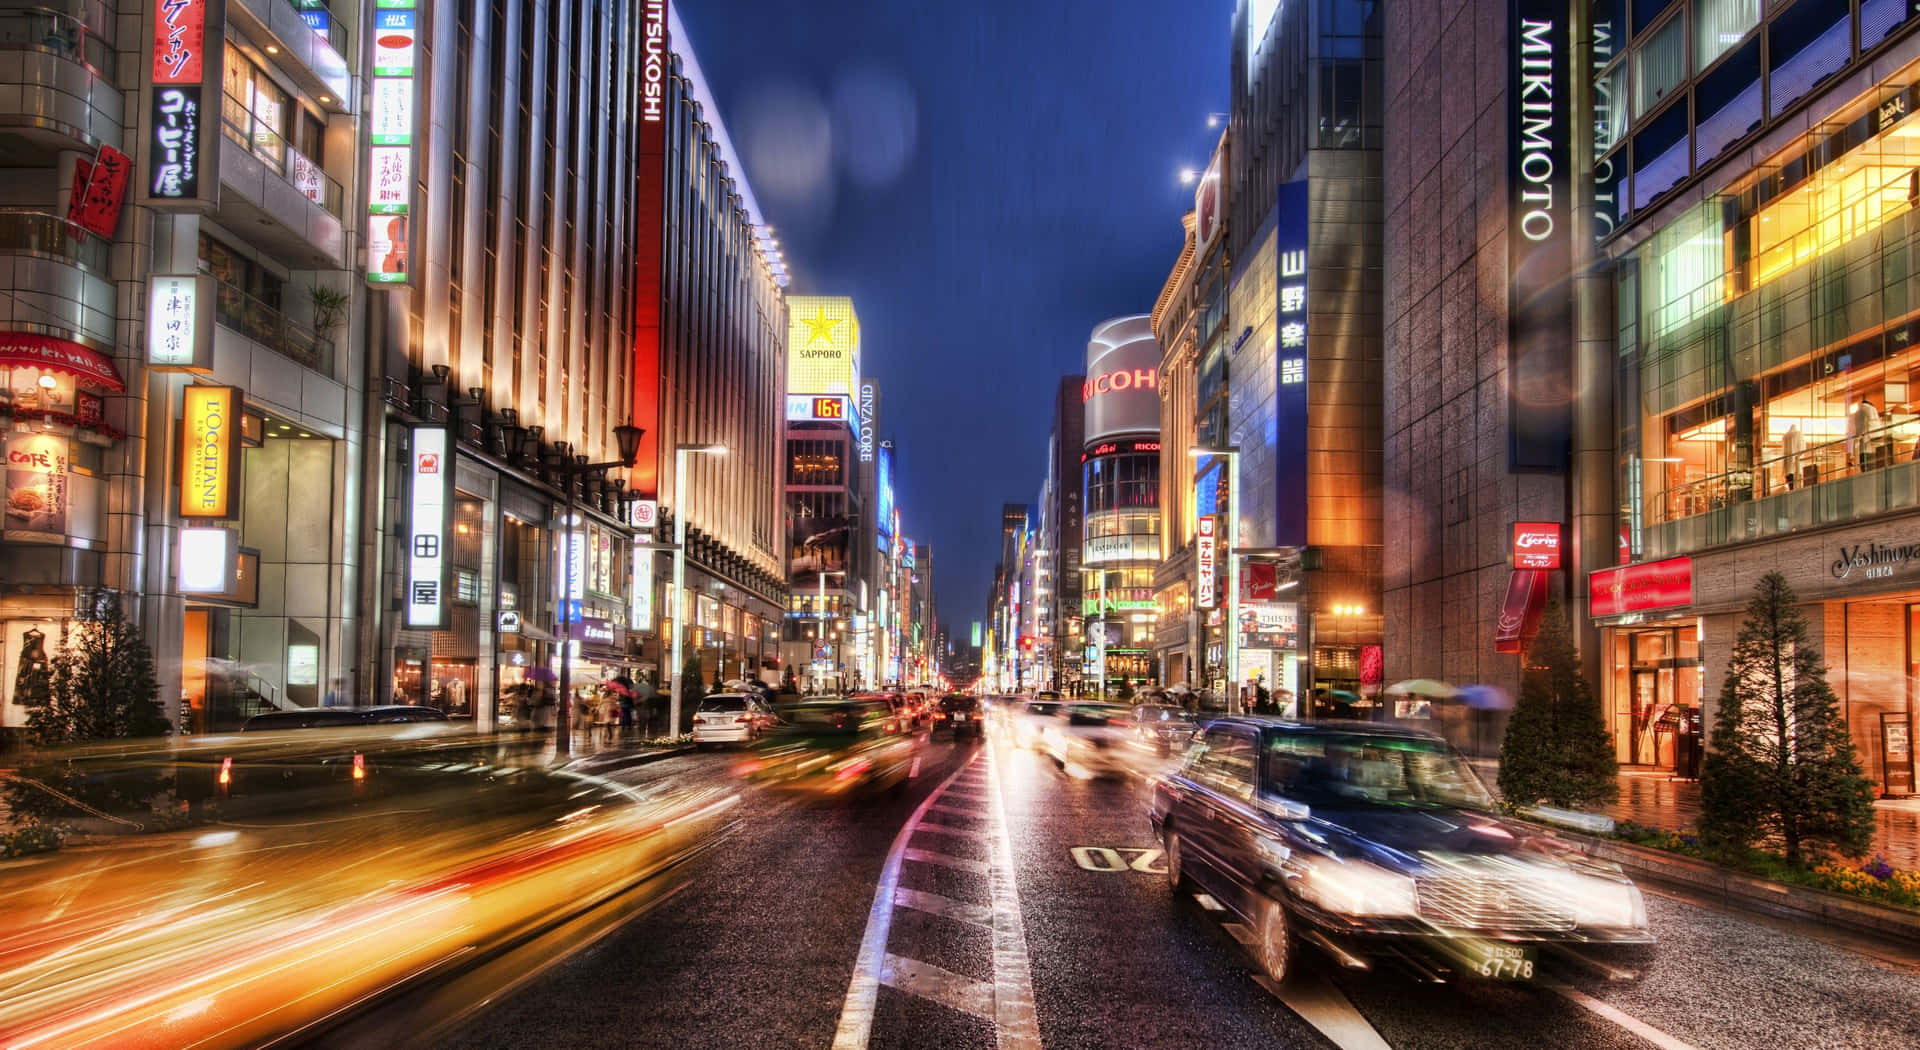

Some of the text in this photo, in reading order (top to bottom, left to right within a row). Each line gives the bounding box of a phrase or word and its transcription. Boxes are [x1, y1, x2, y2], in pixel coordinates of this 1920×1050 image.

[644, 0, 662, 121] ITSUKOSHI
[154, 90, 184, 196] コーヒー屋
[1522, 18, 1553, 241] MIKIMOTO
[800, 350, 842, 359] SAPPORO
[1281, 250, 1305, 385] 山野楽器
[859, 384, 874, 463] GINZA CORE
[1082, 368, 1157, 404] RICOH
[202, 400, 222, 509] L'OCCITANE
[1481, 958, 1534, 978] 67-78
